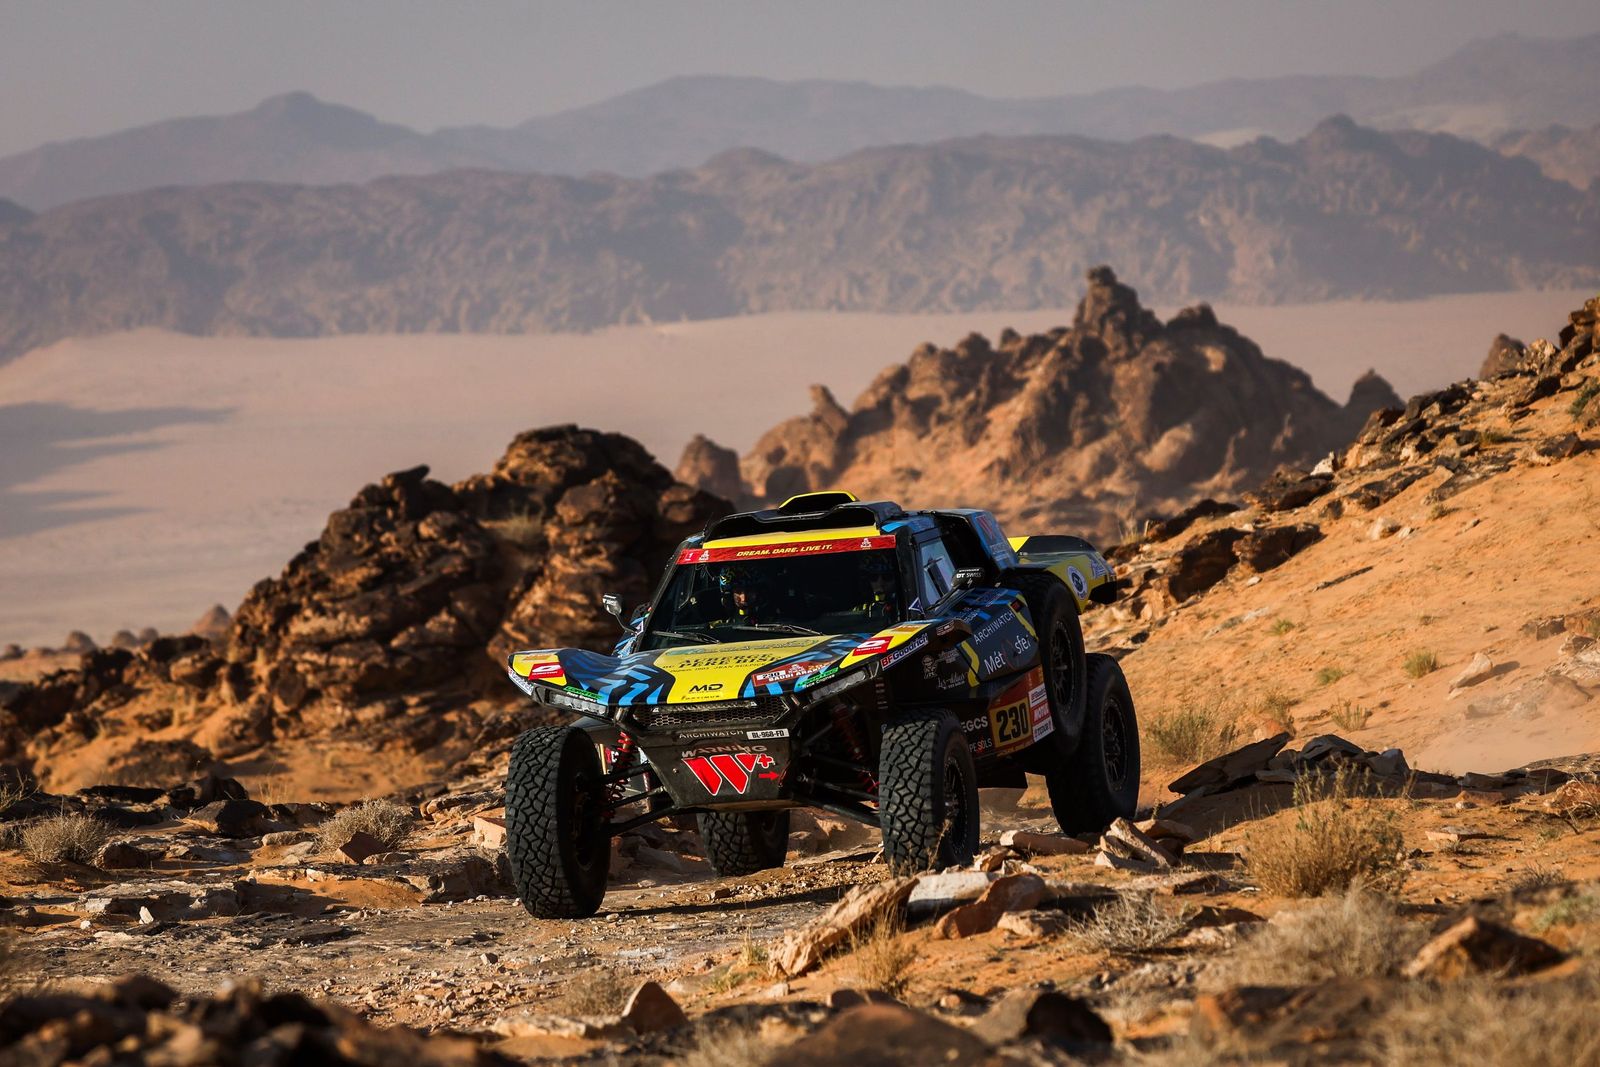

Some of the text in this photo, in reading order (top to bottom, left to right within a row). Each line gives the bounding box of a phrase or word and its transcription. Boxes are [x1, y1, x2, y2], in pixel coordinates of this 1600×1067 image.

[973, 610, 1016, 645] ARCHIWATCH
[881, 633, 928, 668] BFGoodrich
[690, 683, 723, 692] MD
[768, 673, 793, 682] SAUDI
[996, 702, 1029, 742] 230
[679, 730, 744, 739] ARCHIWATCH
